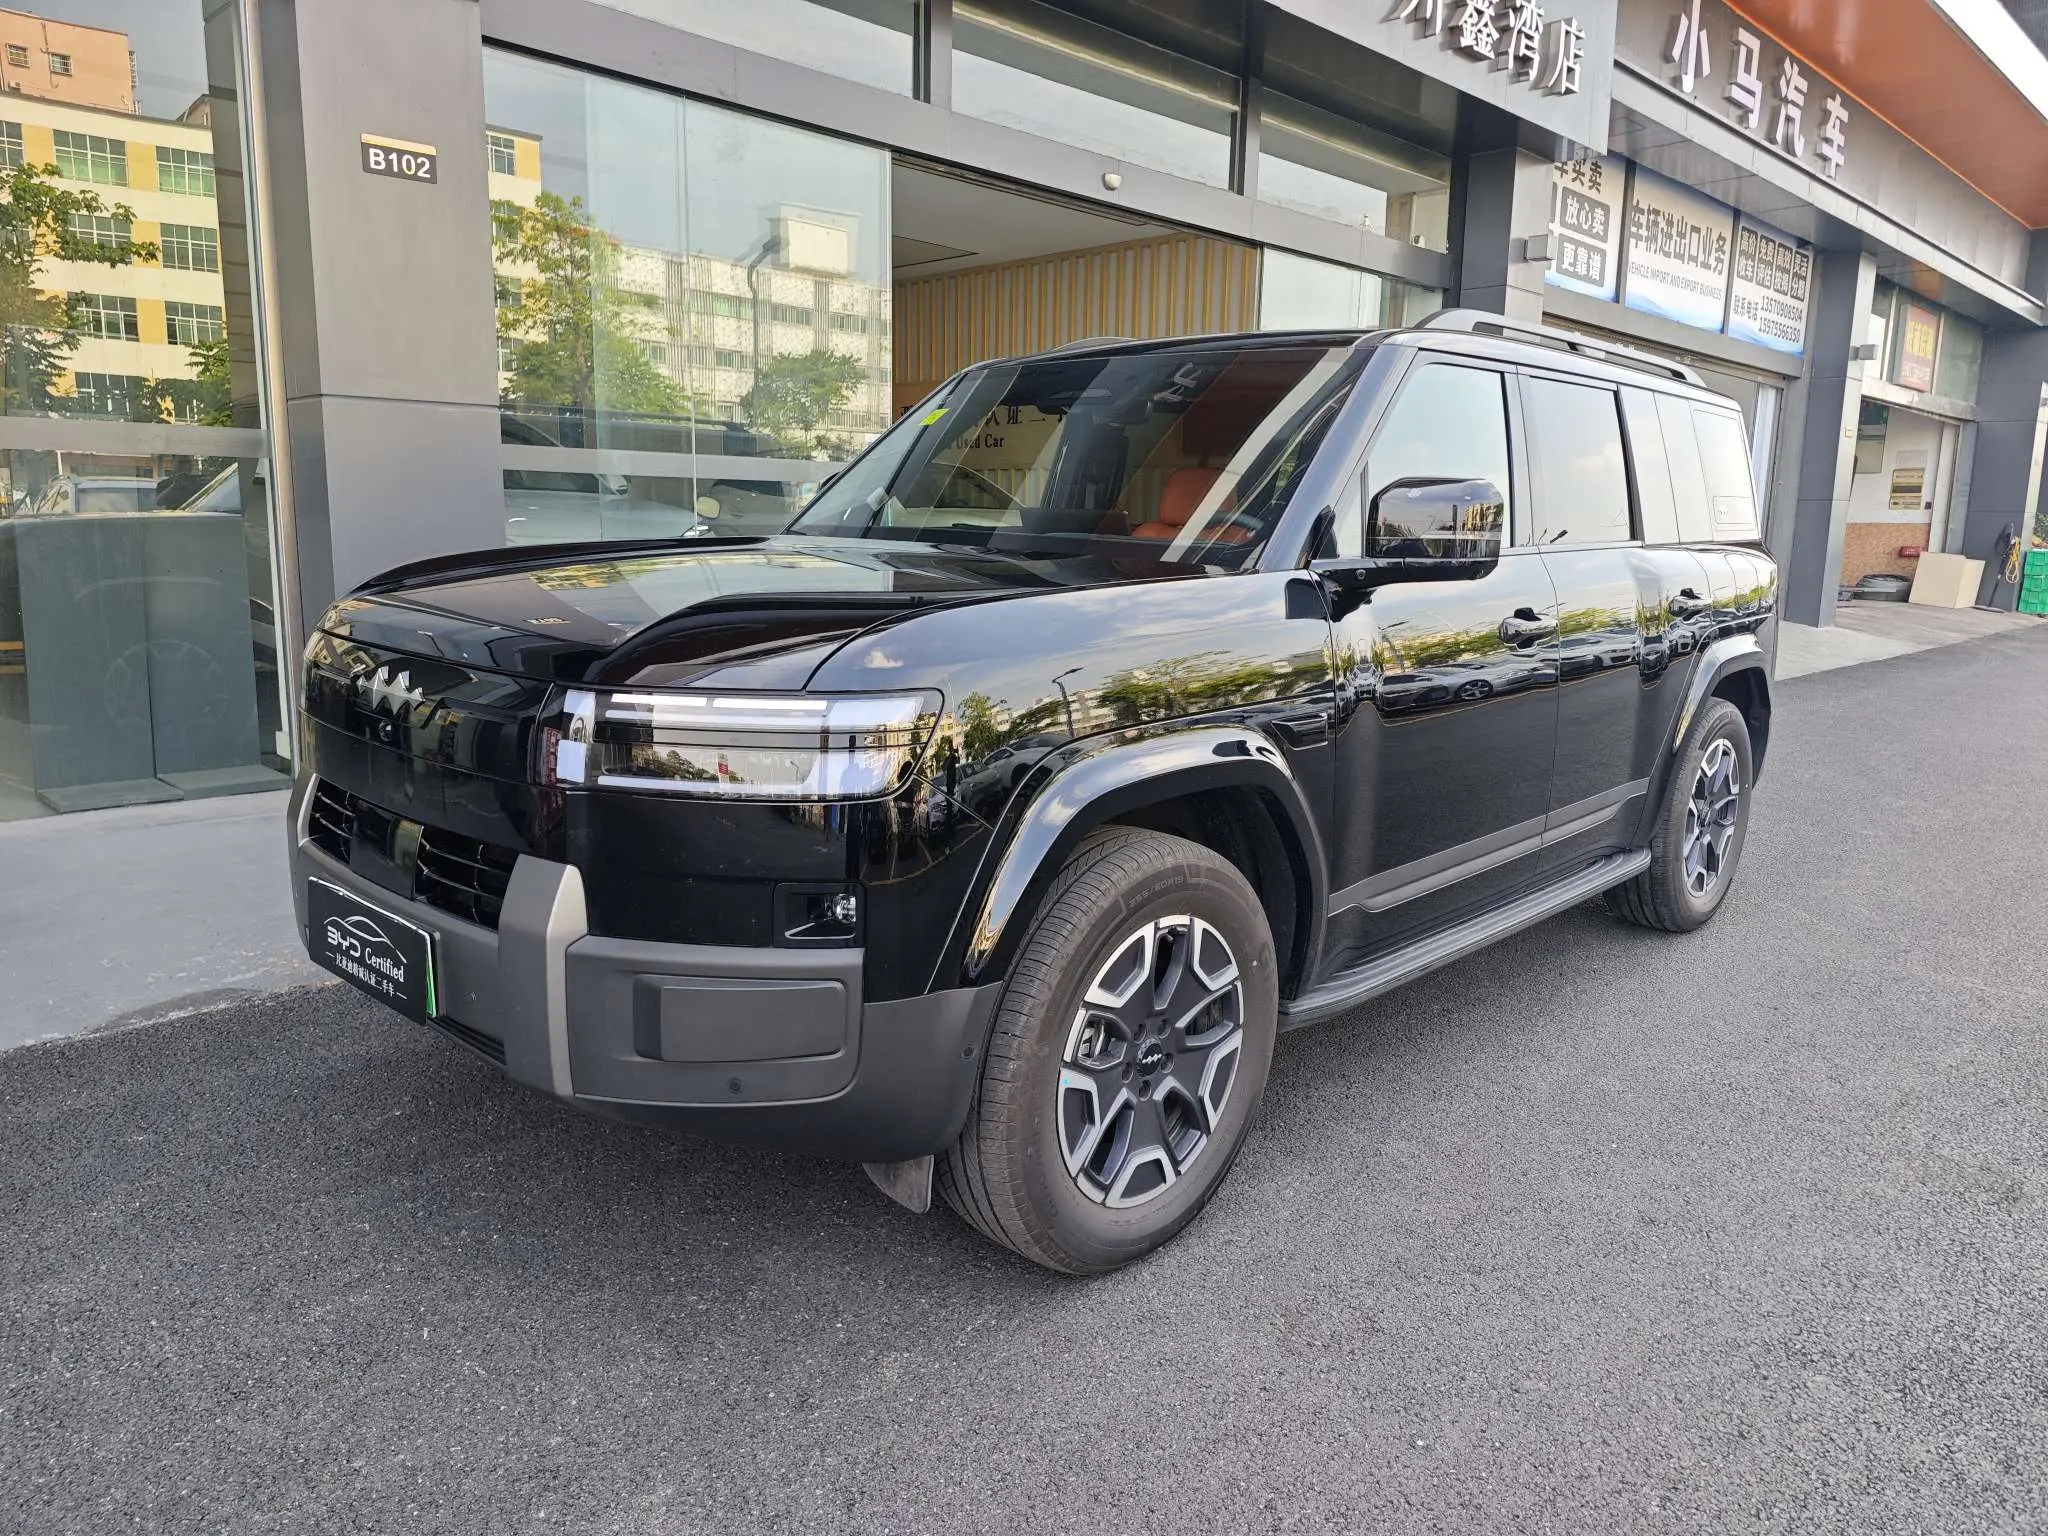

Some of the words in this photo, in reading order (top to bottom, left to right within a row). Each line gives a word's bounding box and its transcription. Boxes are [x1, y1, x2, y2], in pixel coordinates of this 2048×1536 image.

[1671, 0, 1849, 178] 小马汽车
[369, 148, 431, 178] B102
[1565, 196, 1605, 236] 放心卖
[1630, 199, 1727, 276] 车辆进出口业务
[1562, 241, 1602, 281] 更靠谱
[984, 433, 1005, 448] Car
[327, 925, 361, 958] BYD
[365, 947, 404, 983] Certified
